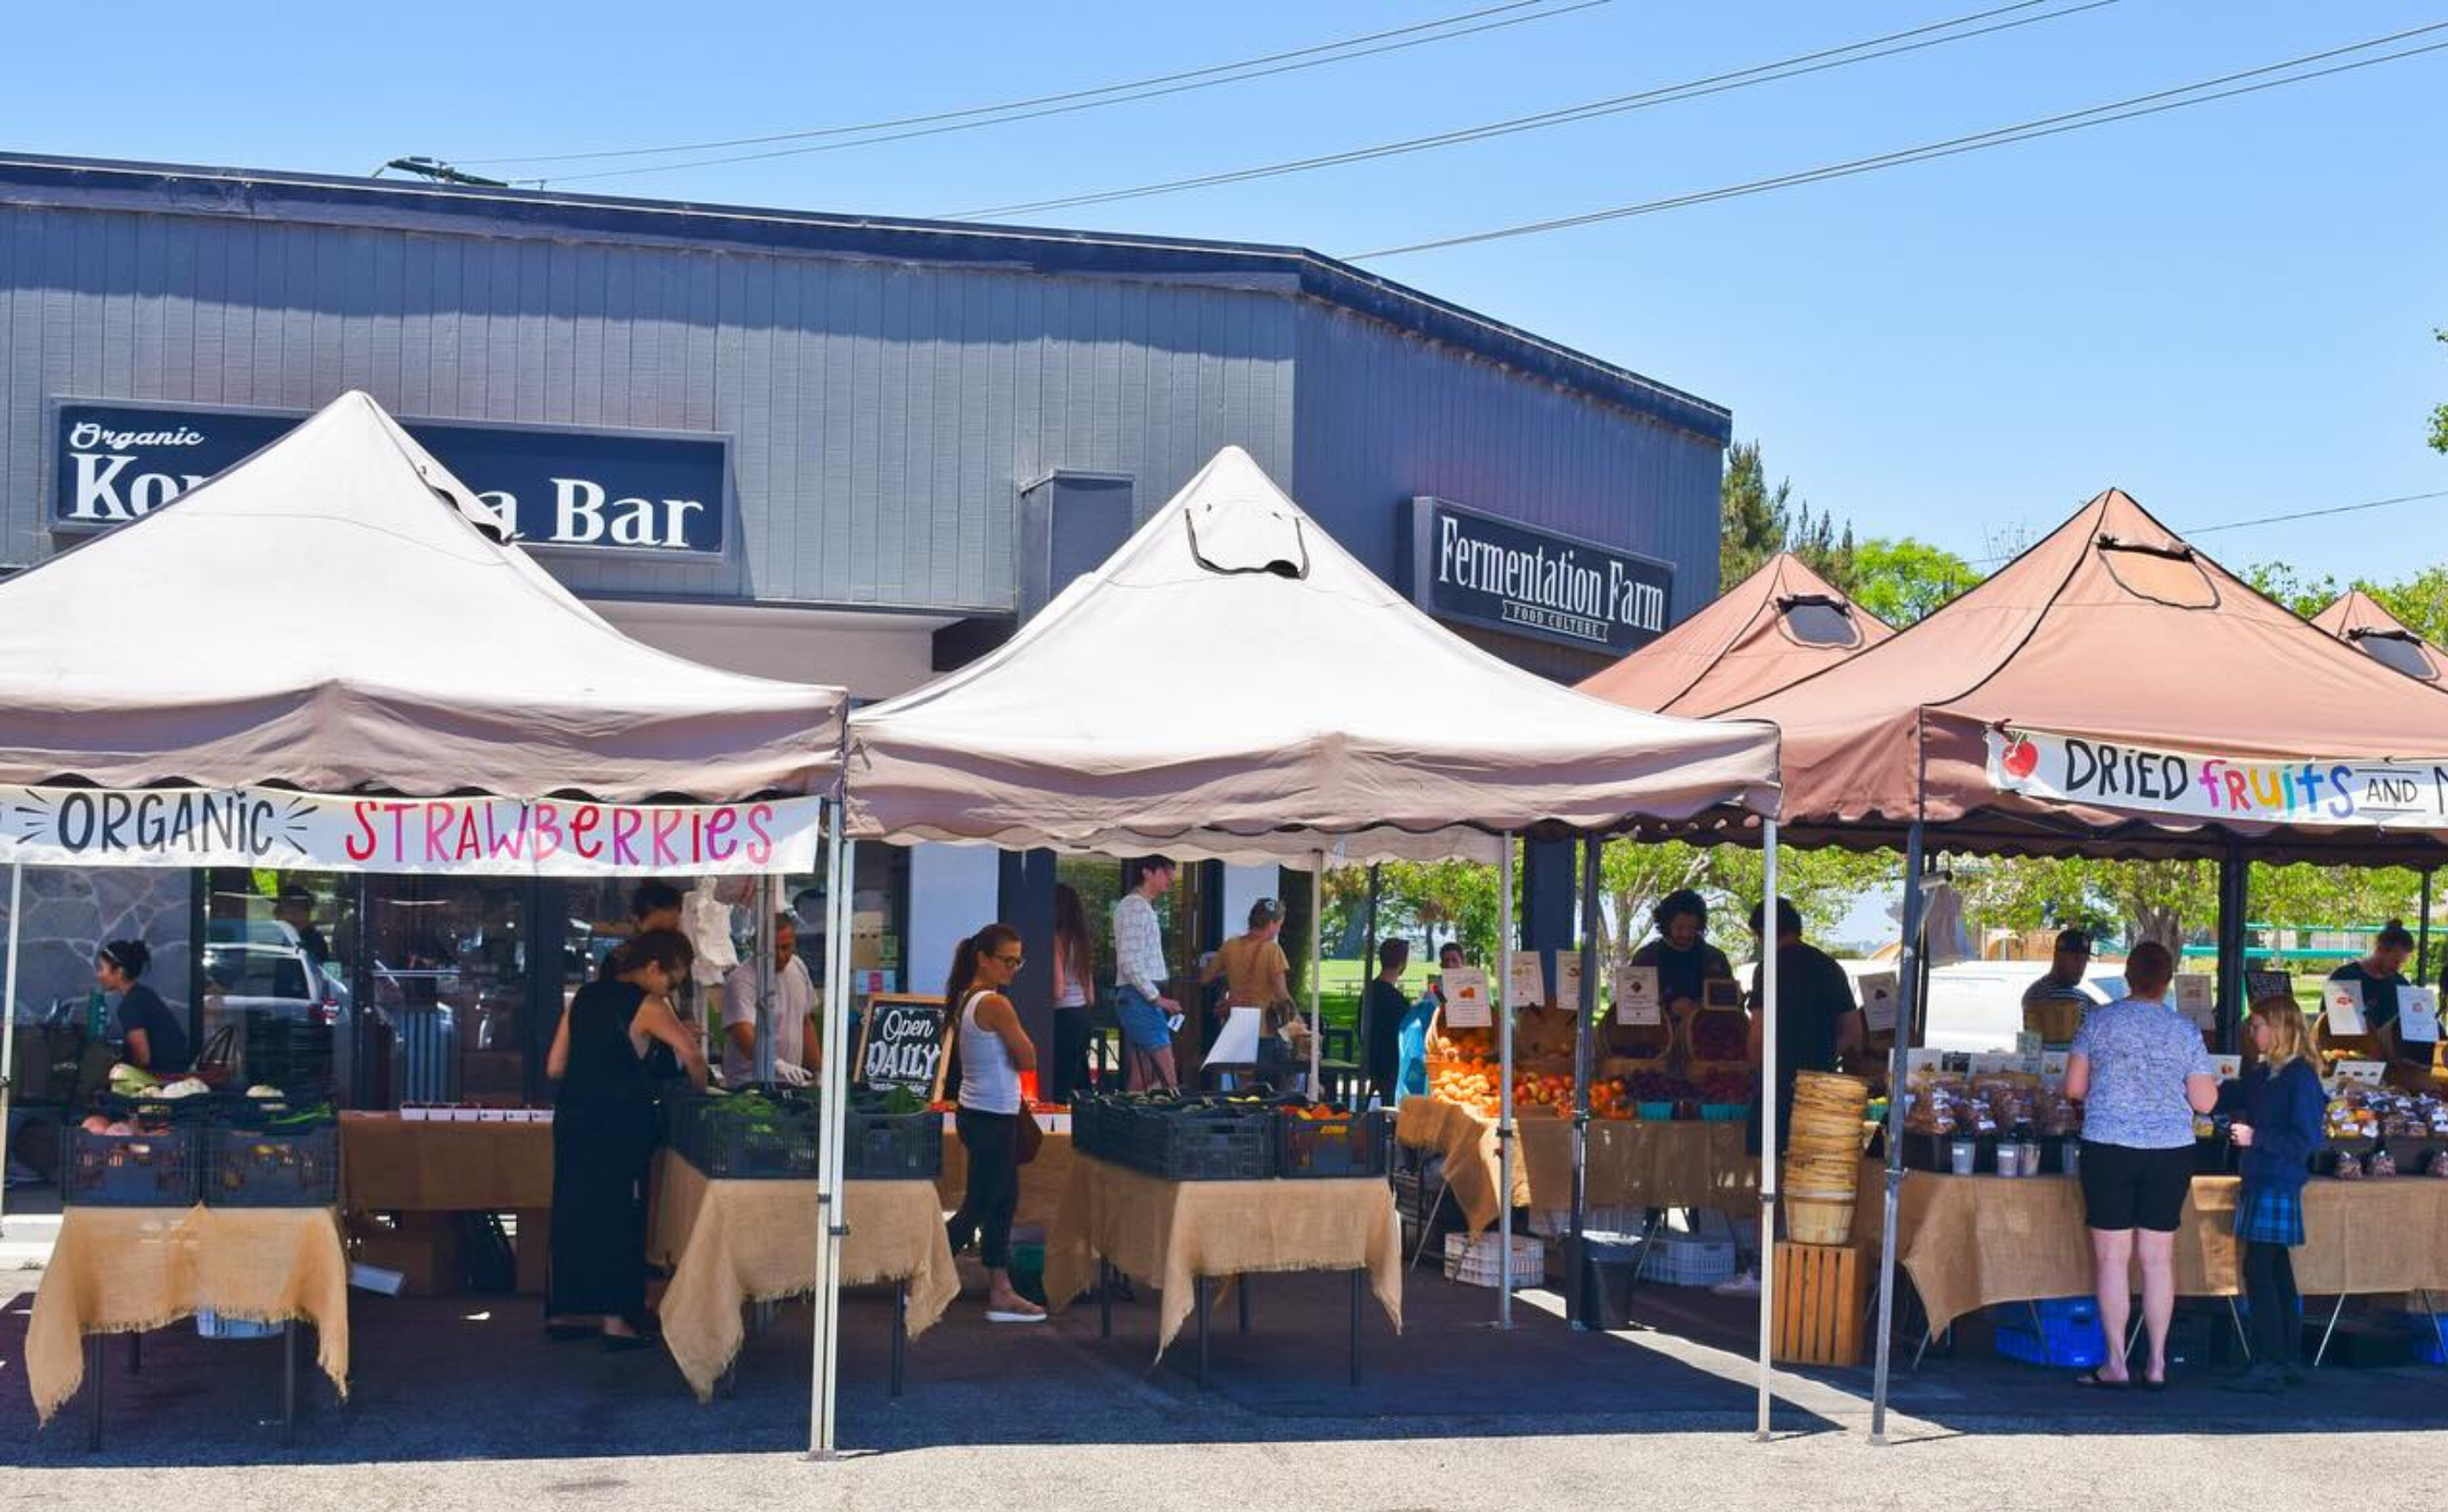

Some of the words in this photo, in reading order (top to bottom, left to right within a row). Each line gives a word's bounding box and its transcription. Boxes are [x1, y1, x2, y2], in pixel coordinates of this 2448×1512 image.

[69, 422, 205, 450] Organic
[549, 478, 704, 547] Bar
[1438, 515, 1602, 619] Fermentation
[1606, 559, 1663, 632] Farm
[1513, 605, 1543, 624] FOOD
[1548, 614, 1598, 637] CULTURE
[2366, 777, 2419, 803] AND
[882, 1009, 934, 1046] Open
[865, 1040, 941, 1081] DAILY
